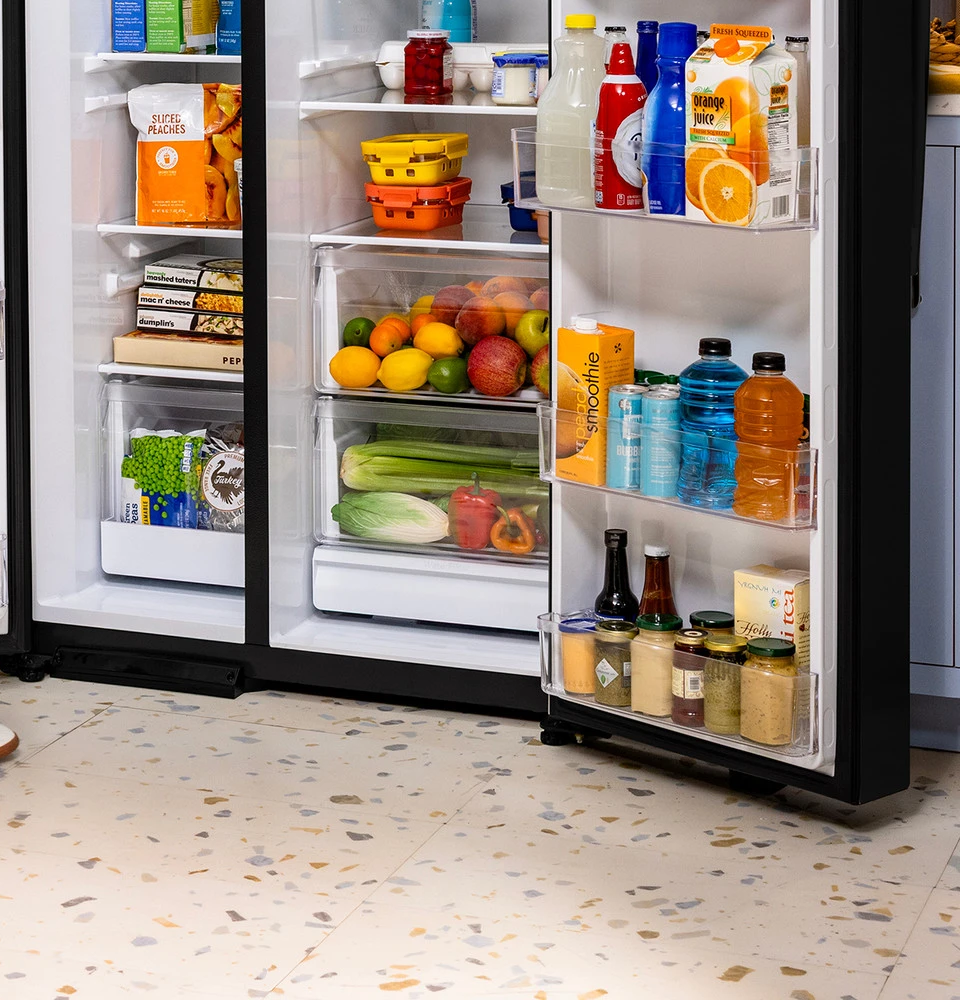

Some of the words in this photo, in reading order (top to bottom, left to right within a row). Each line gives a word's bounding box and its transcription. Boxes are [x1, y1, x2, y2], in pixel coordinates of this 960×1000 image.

[713, 27, 733, 36] FRESH
[735, 28, 769, 38] SQUEEZED
[693, 95, 725, 112] orange
[151, 113, 181, 123] SLICED
[693, 108, 715, 127] juice
[147, 124, 186, 135] PEACHES
[146, 273, 174, 283] mashed
[174, 277, 197, 285] taters
[140, 296, 157, 304] mac
[165, 298, 191, 307] cheese
[139, 318, 175, 328] dumplin's
[222, 357, 241, 365] PEP
[582, 352, 600, 433] smoothie
[616, 445, 639, 456] BUBB
[214, 475, 243, 489] Turkey
[783, 589, 794, 625] tea
[736, 620, 772, 638] Holly
